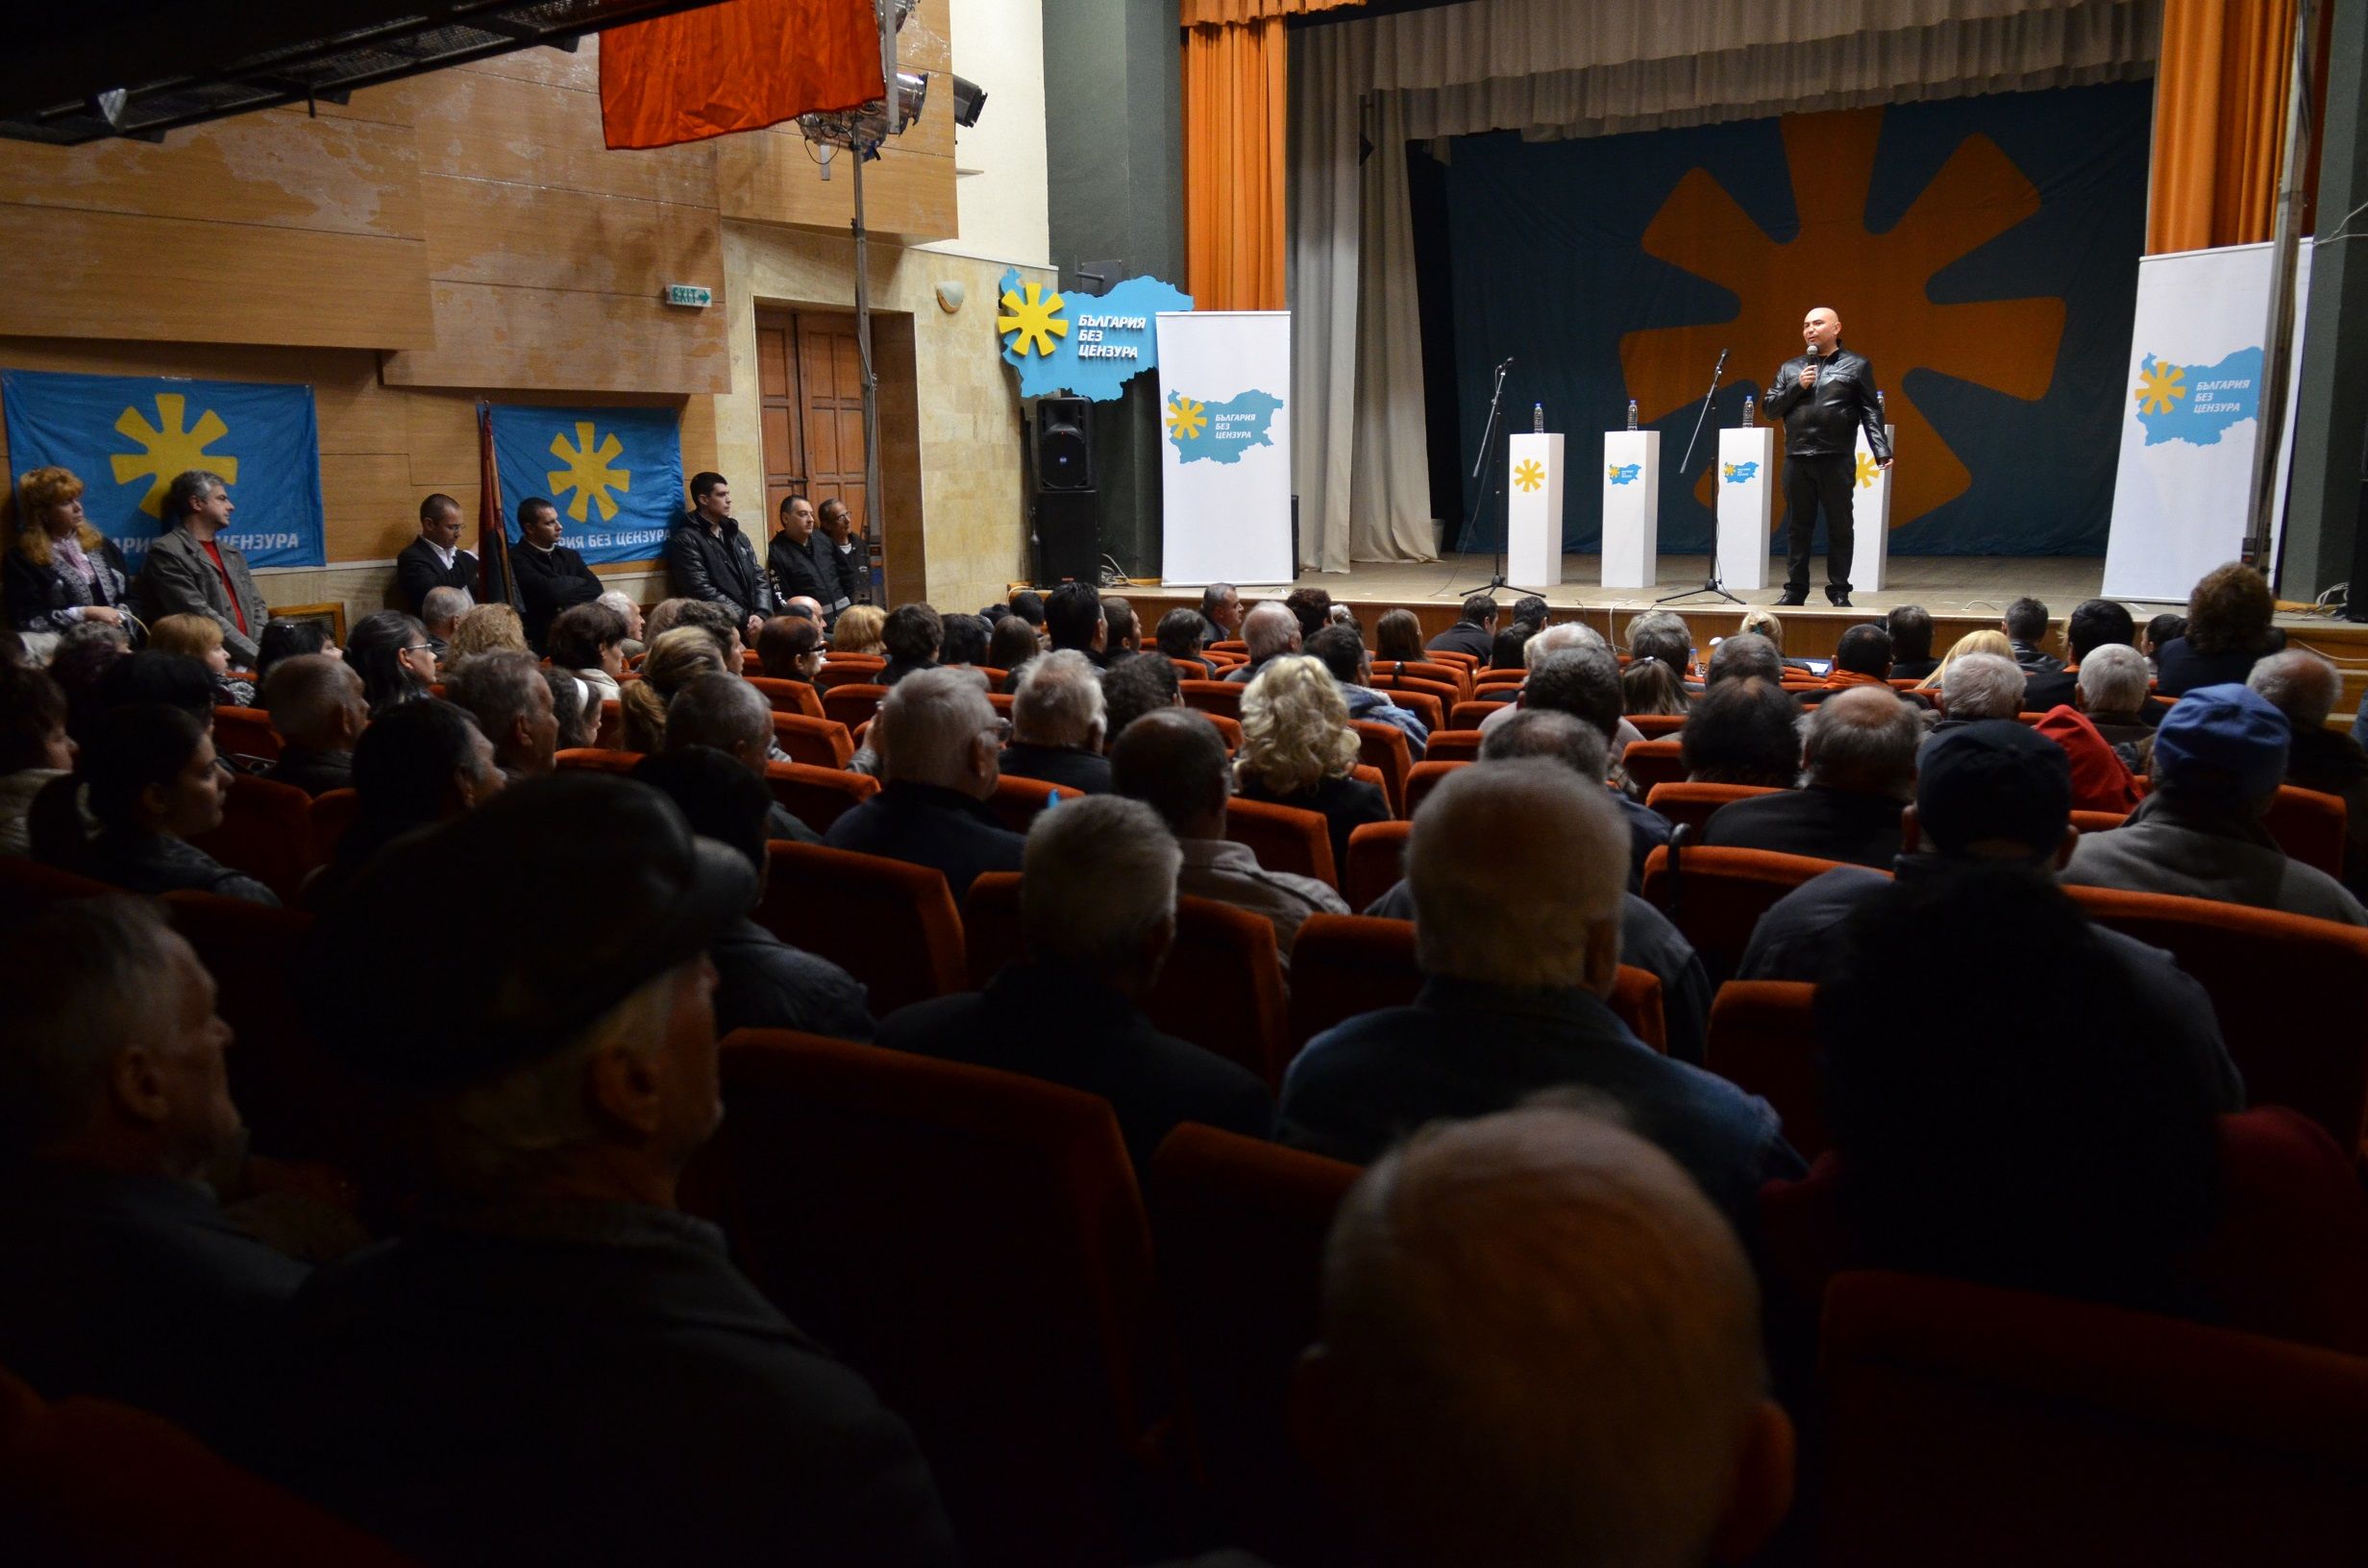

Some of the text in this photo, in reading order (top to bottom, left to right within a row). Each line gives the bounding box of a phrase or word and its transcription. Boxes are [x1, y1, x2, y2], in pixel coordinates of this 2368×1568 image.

[673, 286, 697, 304] EXIT
[1078, 314, 1147, 329] БЪЛГАРИЯ
[1078, 330, 1103, 342] БЕЗ
[1078, 344, 1138, 358] ЦЕНЗУРА
[2196, 379, 2251, 391] БЪЛГАРИЯ
[2194, 392, 2213, 403] БЕЗ
[2193, 403, 2241, 414] ЦЕНЗУРА
[1215, 413, 1256, 422] БЪЛГАРИЯ
[588, 534, 612, 547] БЕЗ
[616, 528, 671, 547] ЦЕНЗУРА
